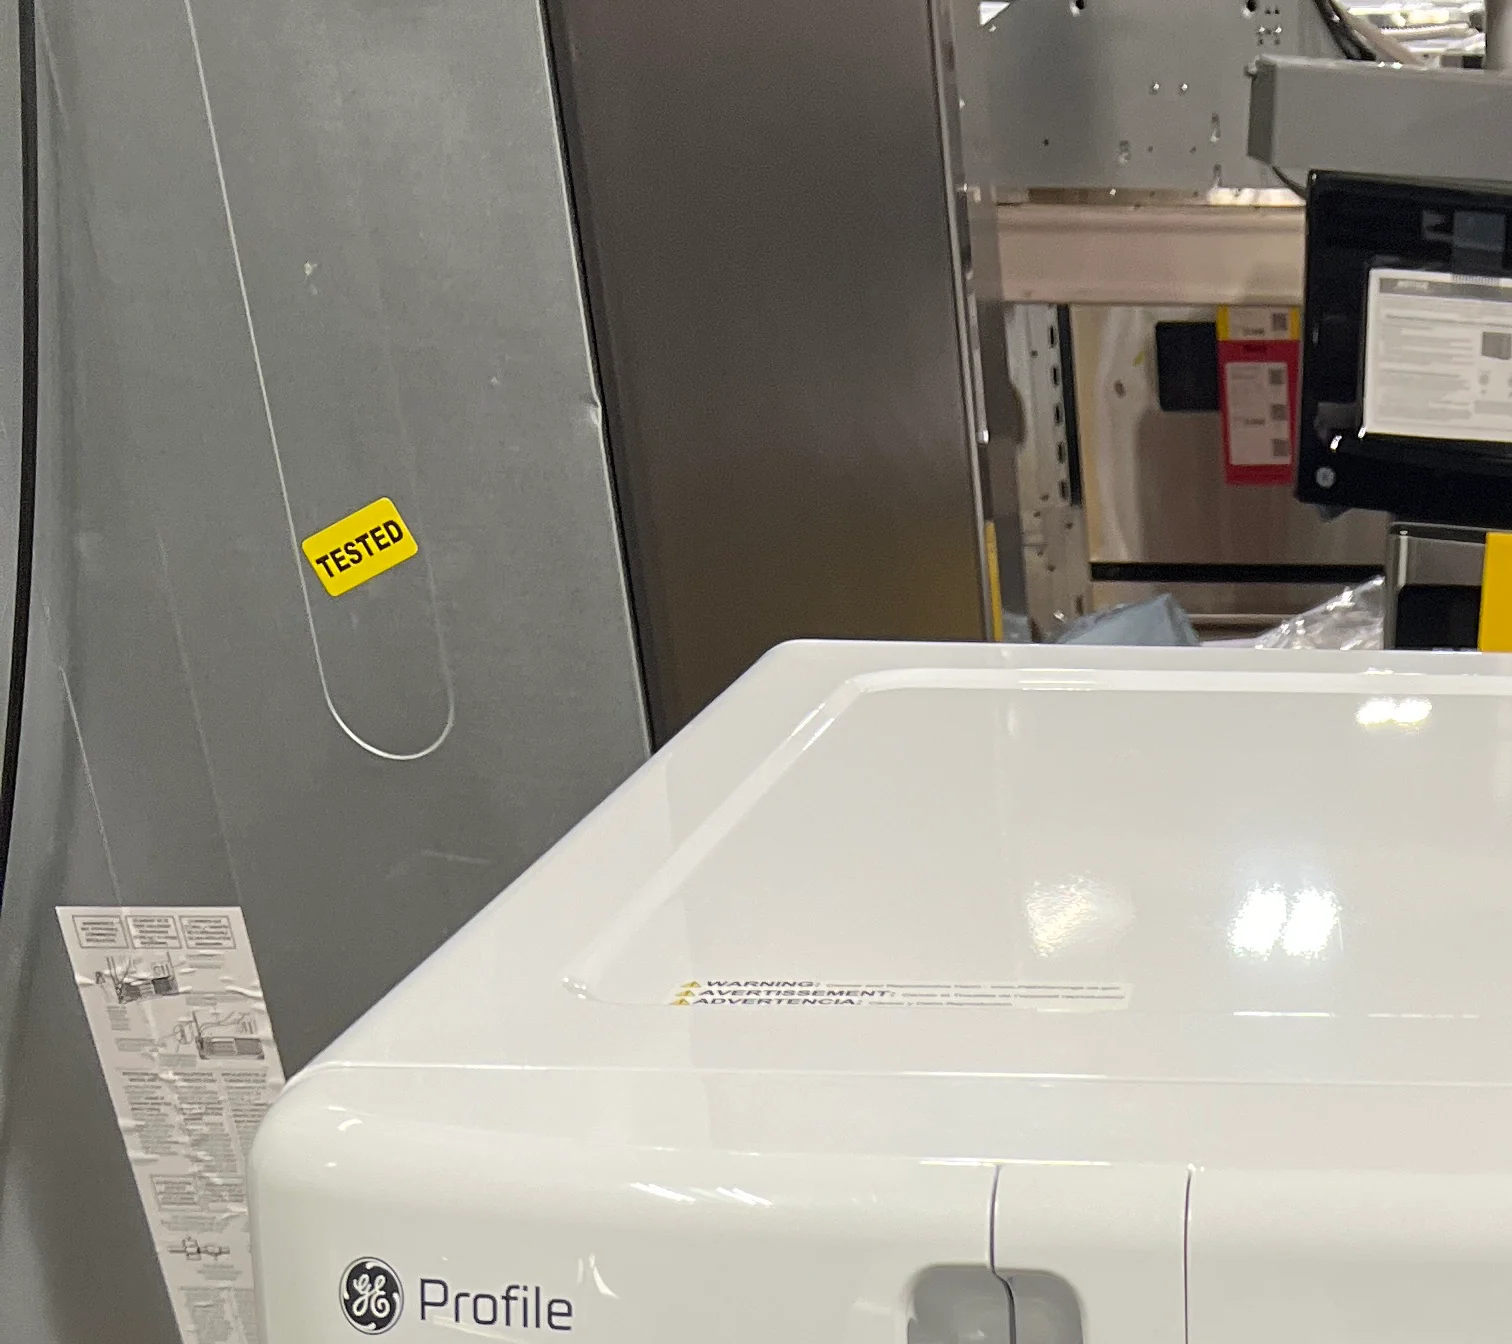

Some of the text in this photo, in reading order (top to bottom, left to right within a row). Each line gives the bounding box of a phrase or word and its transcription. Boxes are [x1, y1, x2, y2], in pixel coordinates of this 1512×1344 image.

[316, 520, 404, 578] TESTED
[693, 998, 863, 1006] ADVERTENCIA:
[419, 1277, 574, 1332] Profile
